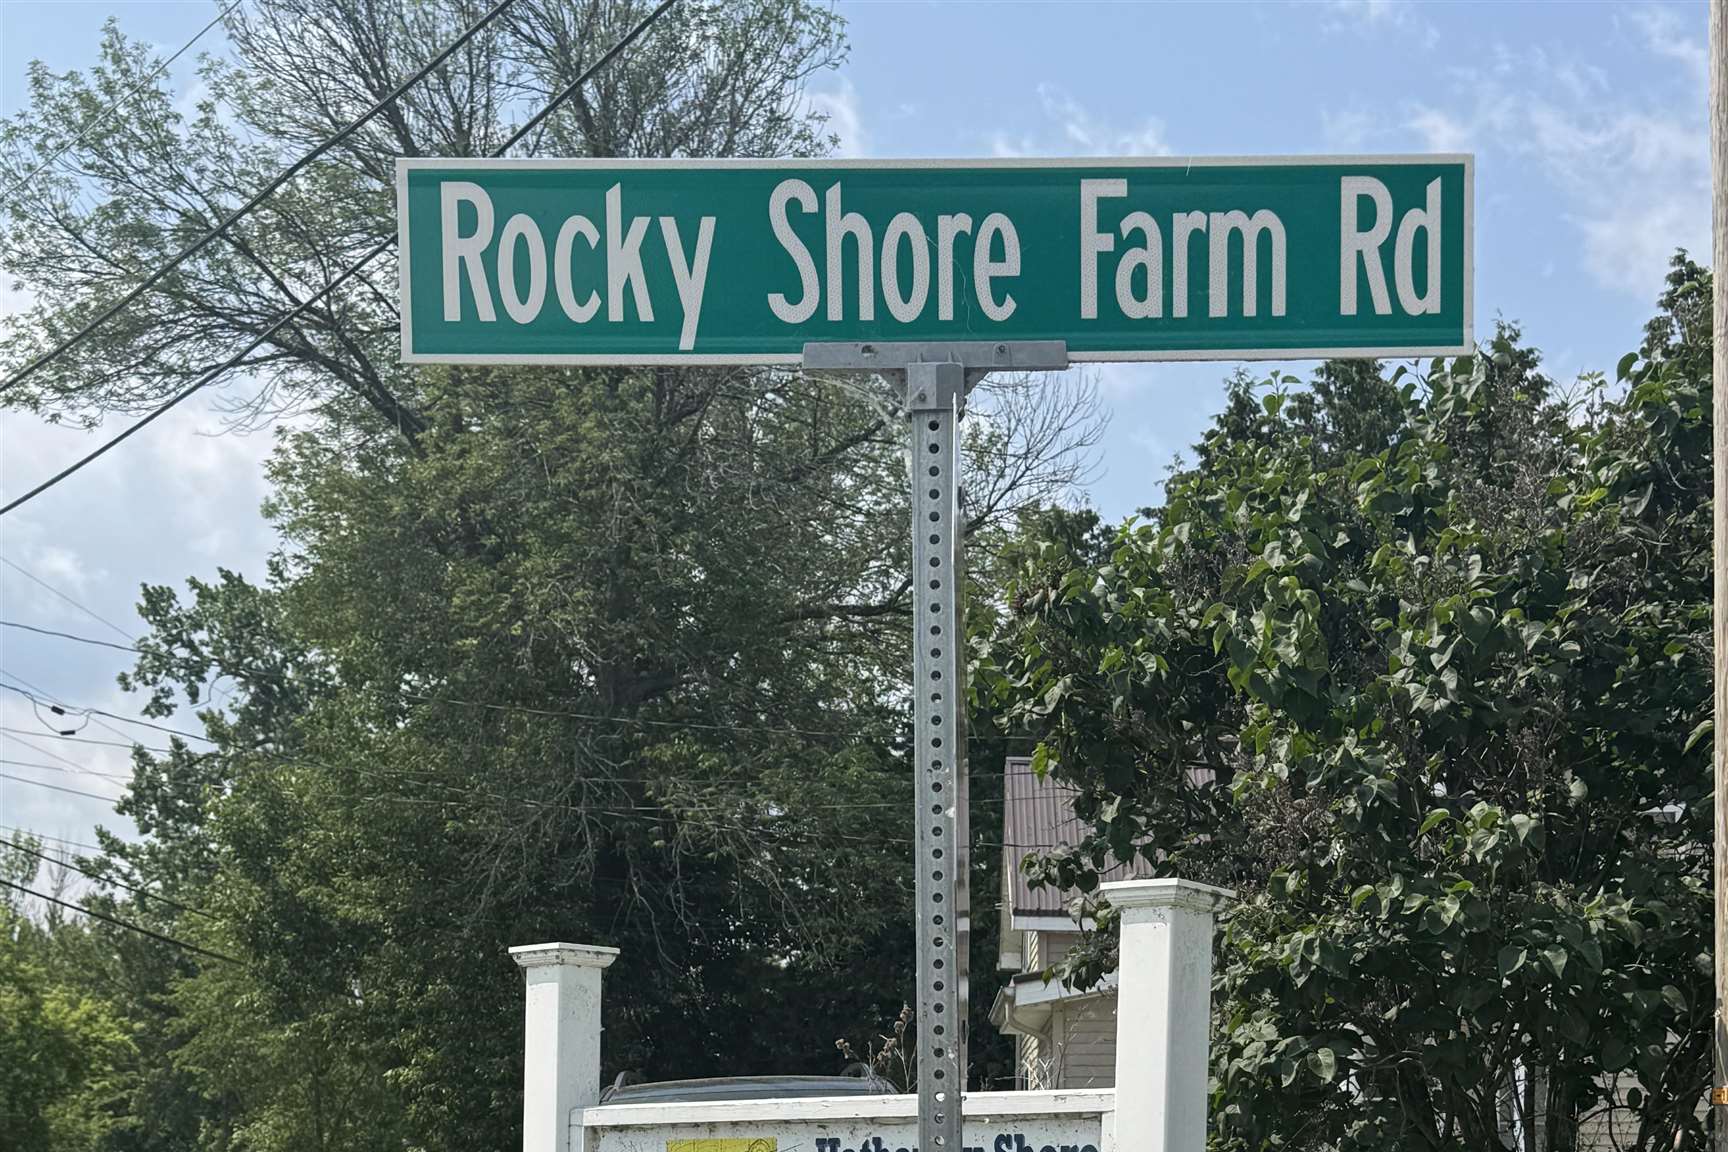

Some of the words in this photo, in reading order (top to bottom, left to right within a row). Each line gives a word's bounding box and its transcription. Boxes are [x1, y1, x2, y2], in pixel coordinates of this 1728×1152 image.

[440, 181, 716, 351] Rocky
[767, 178, 1019, 324] Shore
[1080, 178, 1288, 319] Farm
[1340, 176, 1443, 317] Rd
